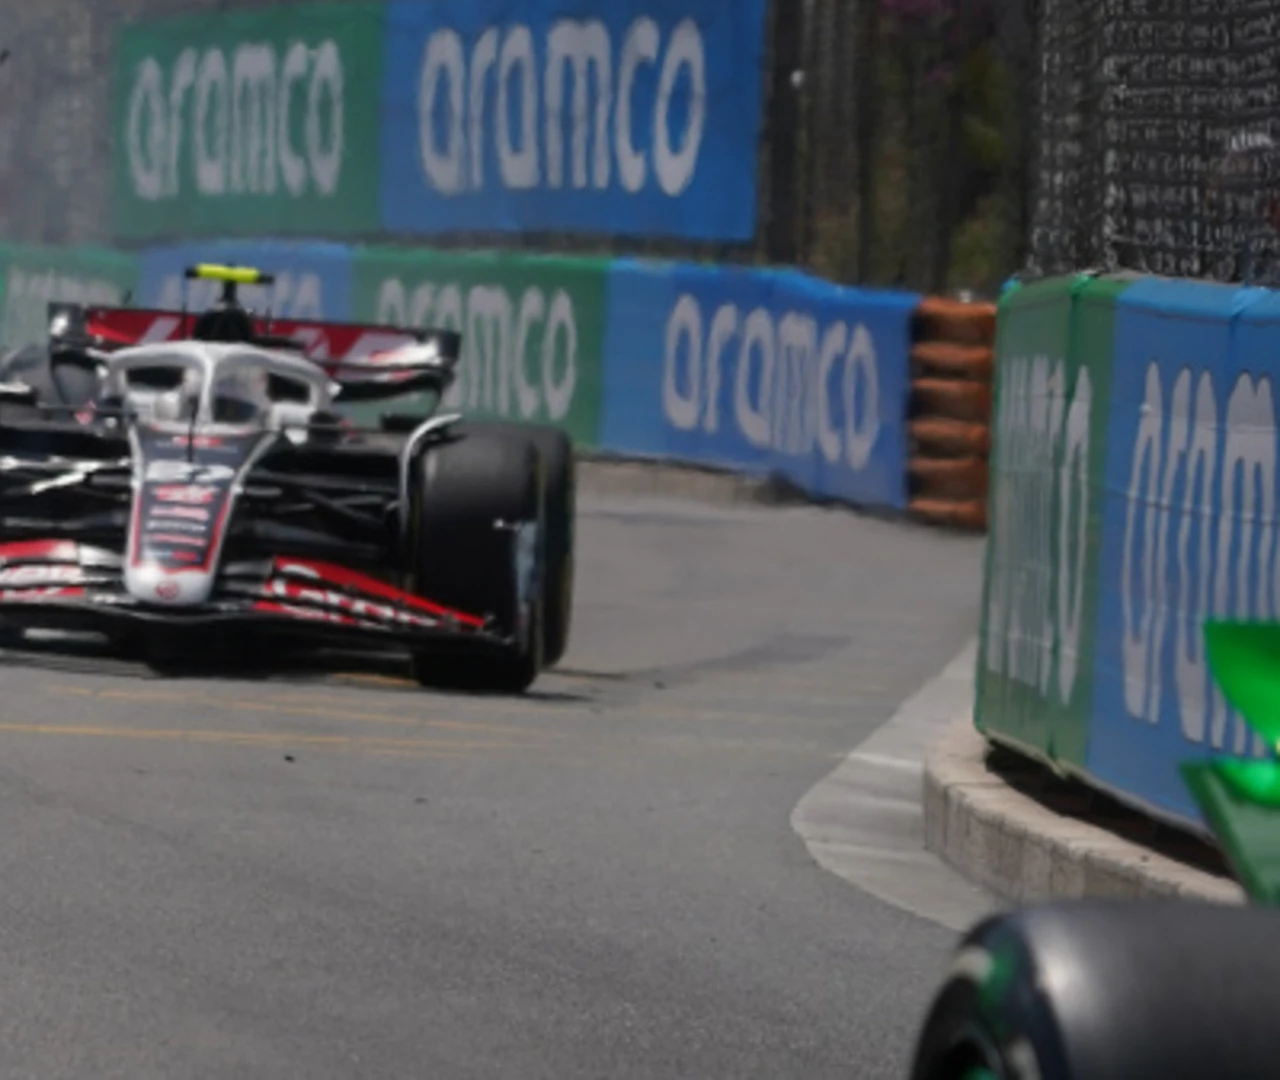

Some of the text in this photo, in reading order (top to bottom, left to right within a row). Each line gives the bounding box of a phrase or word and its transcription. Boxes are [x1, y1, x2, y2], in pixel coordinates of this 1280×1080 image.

[128, 39, 343, 200] aramco
[419, 16, 705, 197] aramco
[663, 294, 879, 471] aramco
[1121, 360, 1280, 758] aram
